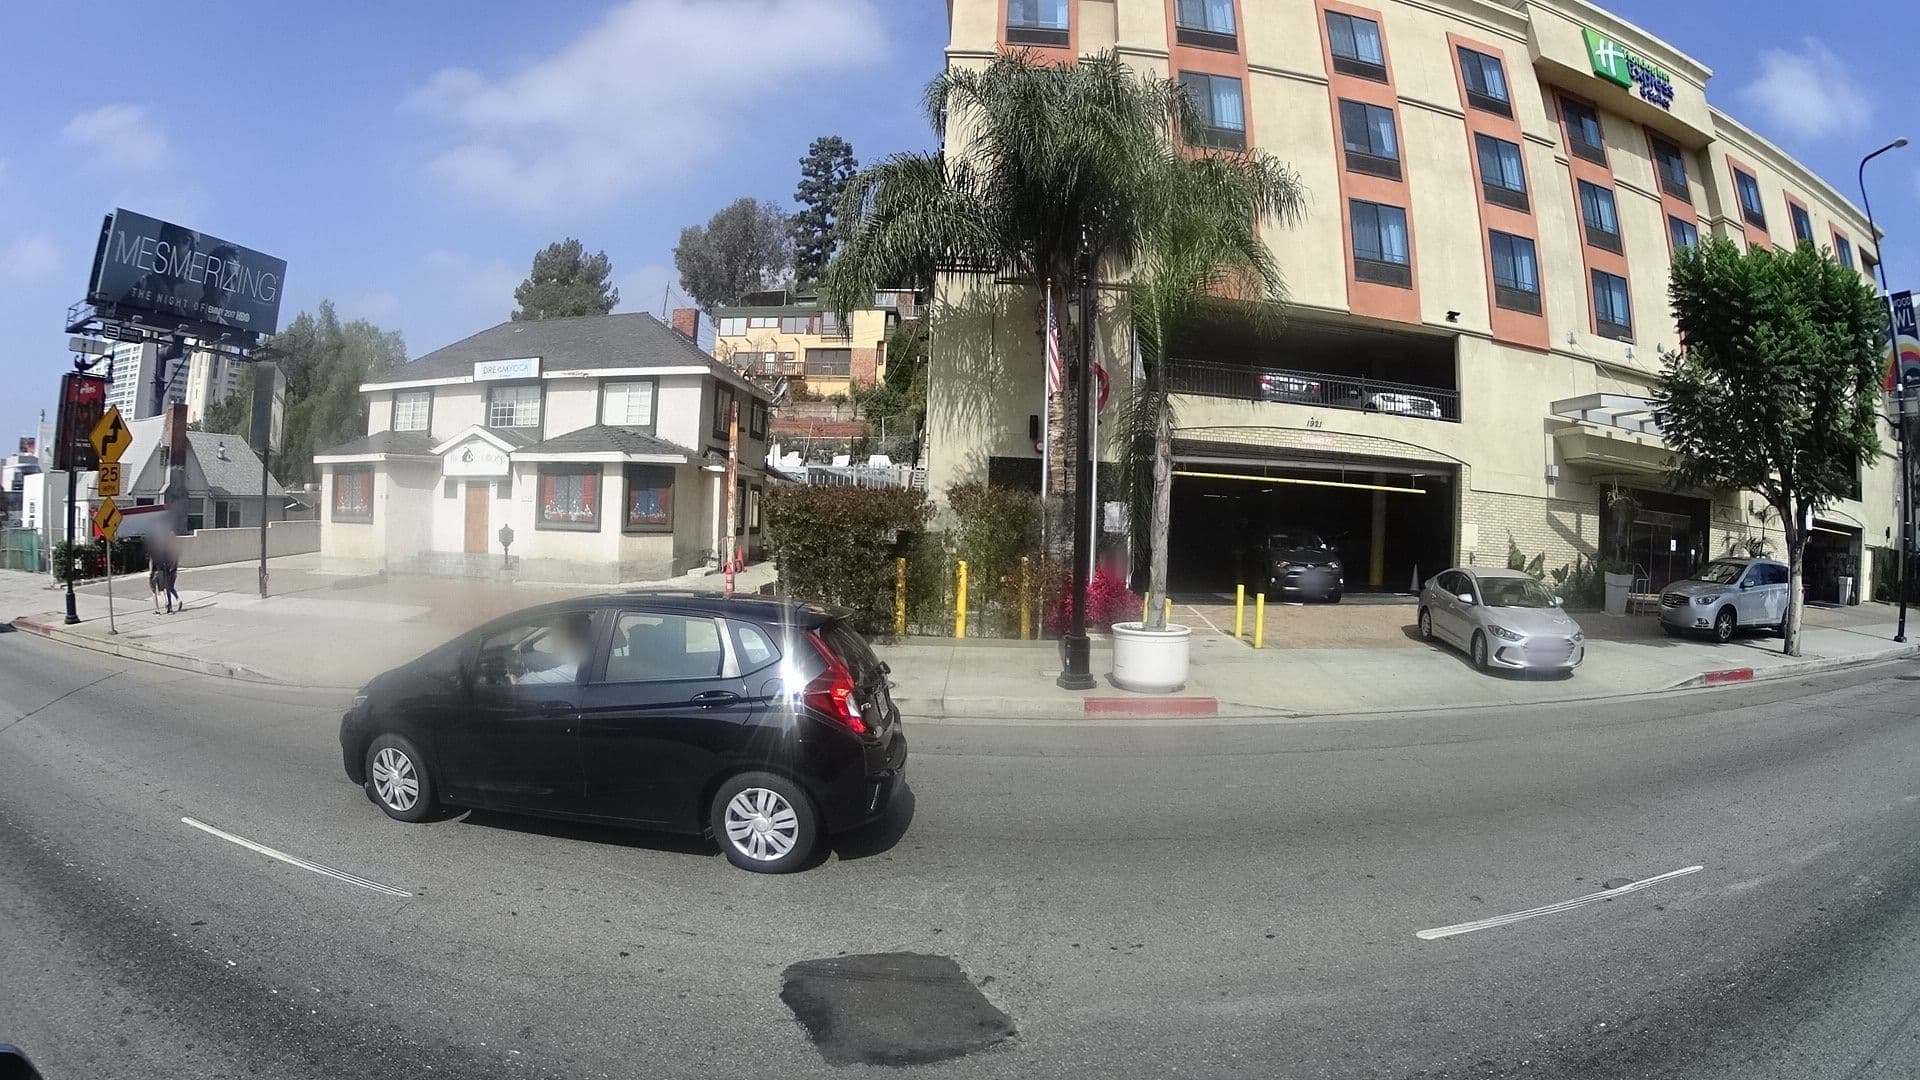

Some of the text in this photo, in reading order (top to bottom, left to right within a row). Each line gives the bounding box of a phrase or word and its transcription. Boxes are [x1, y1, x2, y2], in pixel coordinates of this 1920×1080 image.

[132, 288, 151, 300] THE
[157, 294, 188, 307] NIGHT
[194, 301, 206, 312] OF
[1306, 420, 1322, 428] 1921
[101, 467, 118, 482] 25
